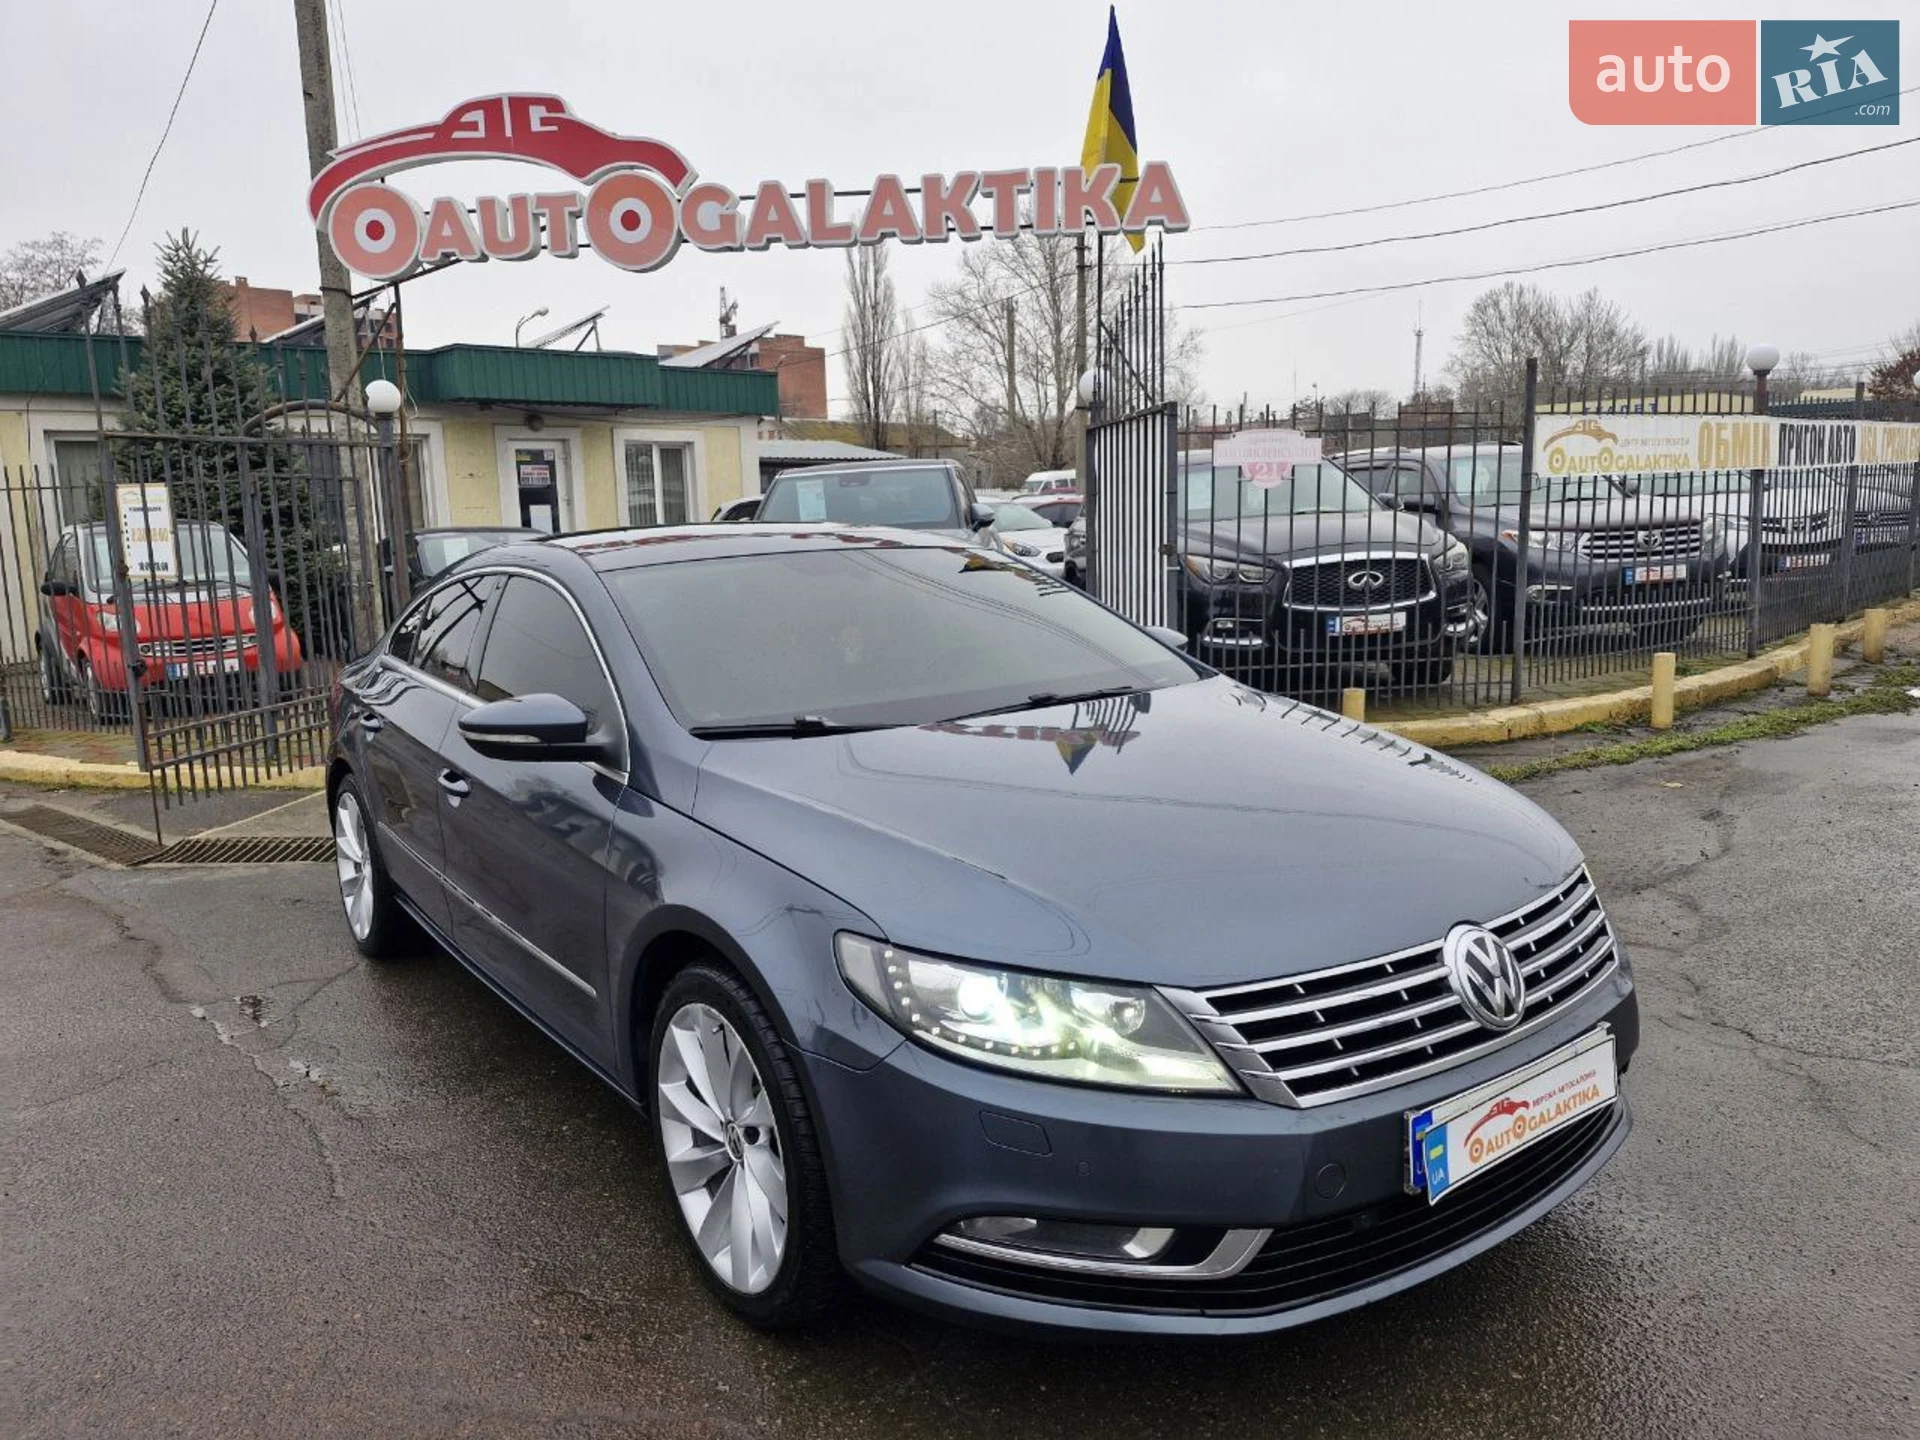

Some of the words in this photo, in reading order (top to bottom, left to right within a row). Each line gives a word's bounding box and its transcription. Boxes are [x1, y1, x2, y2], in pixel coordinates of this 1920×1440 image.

[1778, 423, 1825, 467] ПРИГОН
[1828, 424, 1856, 465] АВТО
[1432, 1167, 1445, 1186] UA
